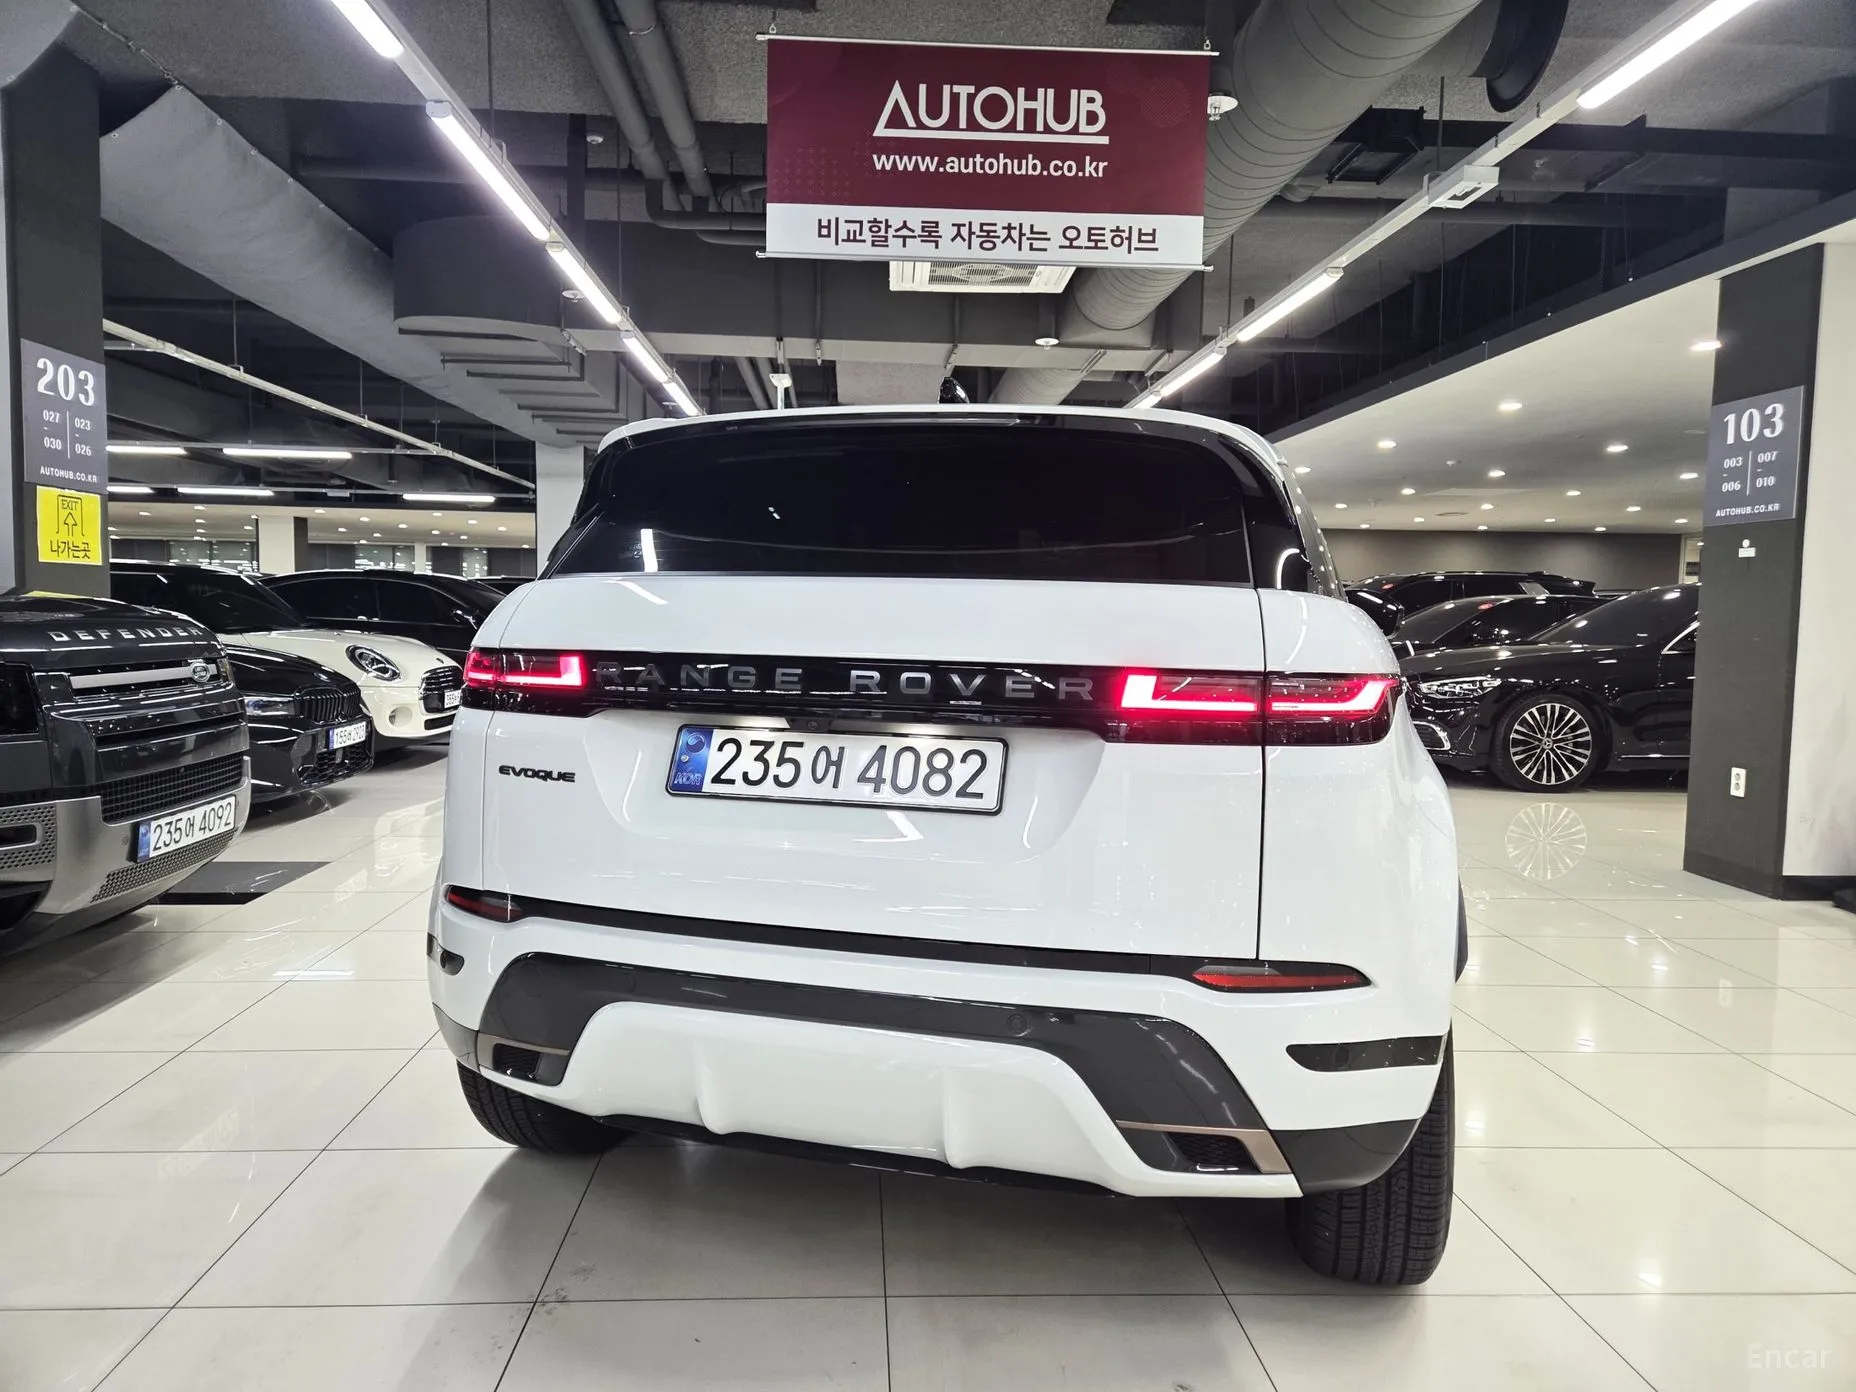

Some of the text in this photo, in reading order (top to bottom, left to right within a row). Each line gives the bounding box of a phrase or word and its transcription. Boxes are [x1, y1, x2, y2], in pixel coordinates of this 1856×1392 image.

[872, 80, 1109, 141] AUTOHUB
[872, 153, 1109, 178] www.autohub.co.kr
[816, 217, 1160, 254] 비교할수록 자동차는 오토허브
[36, 357, 95, 407] 203
[43, 409, 60, 423] 027
[74, 417, 91, 431] 023
[1723, 402, 1785, 445] 103
[44, 436, 62, 450] 030
[75, 443, 92, 457] 026
[1723, 456, 1743, 469] 003
[1757, 451, 1778, 463] 007
[40, 466, 98, 483] AUTOHUB.CO.KR
[1756, 476, 1776, 488] 010
[1722, 480, 1741, 492] 006
[61, 500, 79, 511] EXIT
[1715, 503, 1780, 517] AUTOHUB.CO.KR
[50, 539, 91, 559] 나가는곳
[48, 626, 203, 642] DEFENDER
[596, 662, 1094, 701] RANGE ROVER
[498, 764, 576, 783] EVOQUE
[710, 737, 988, 800] 235어 4082
[152, 802, 232, 852] 235어 4092
